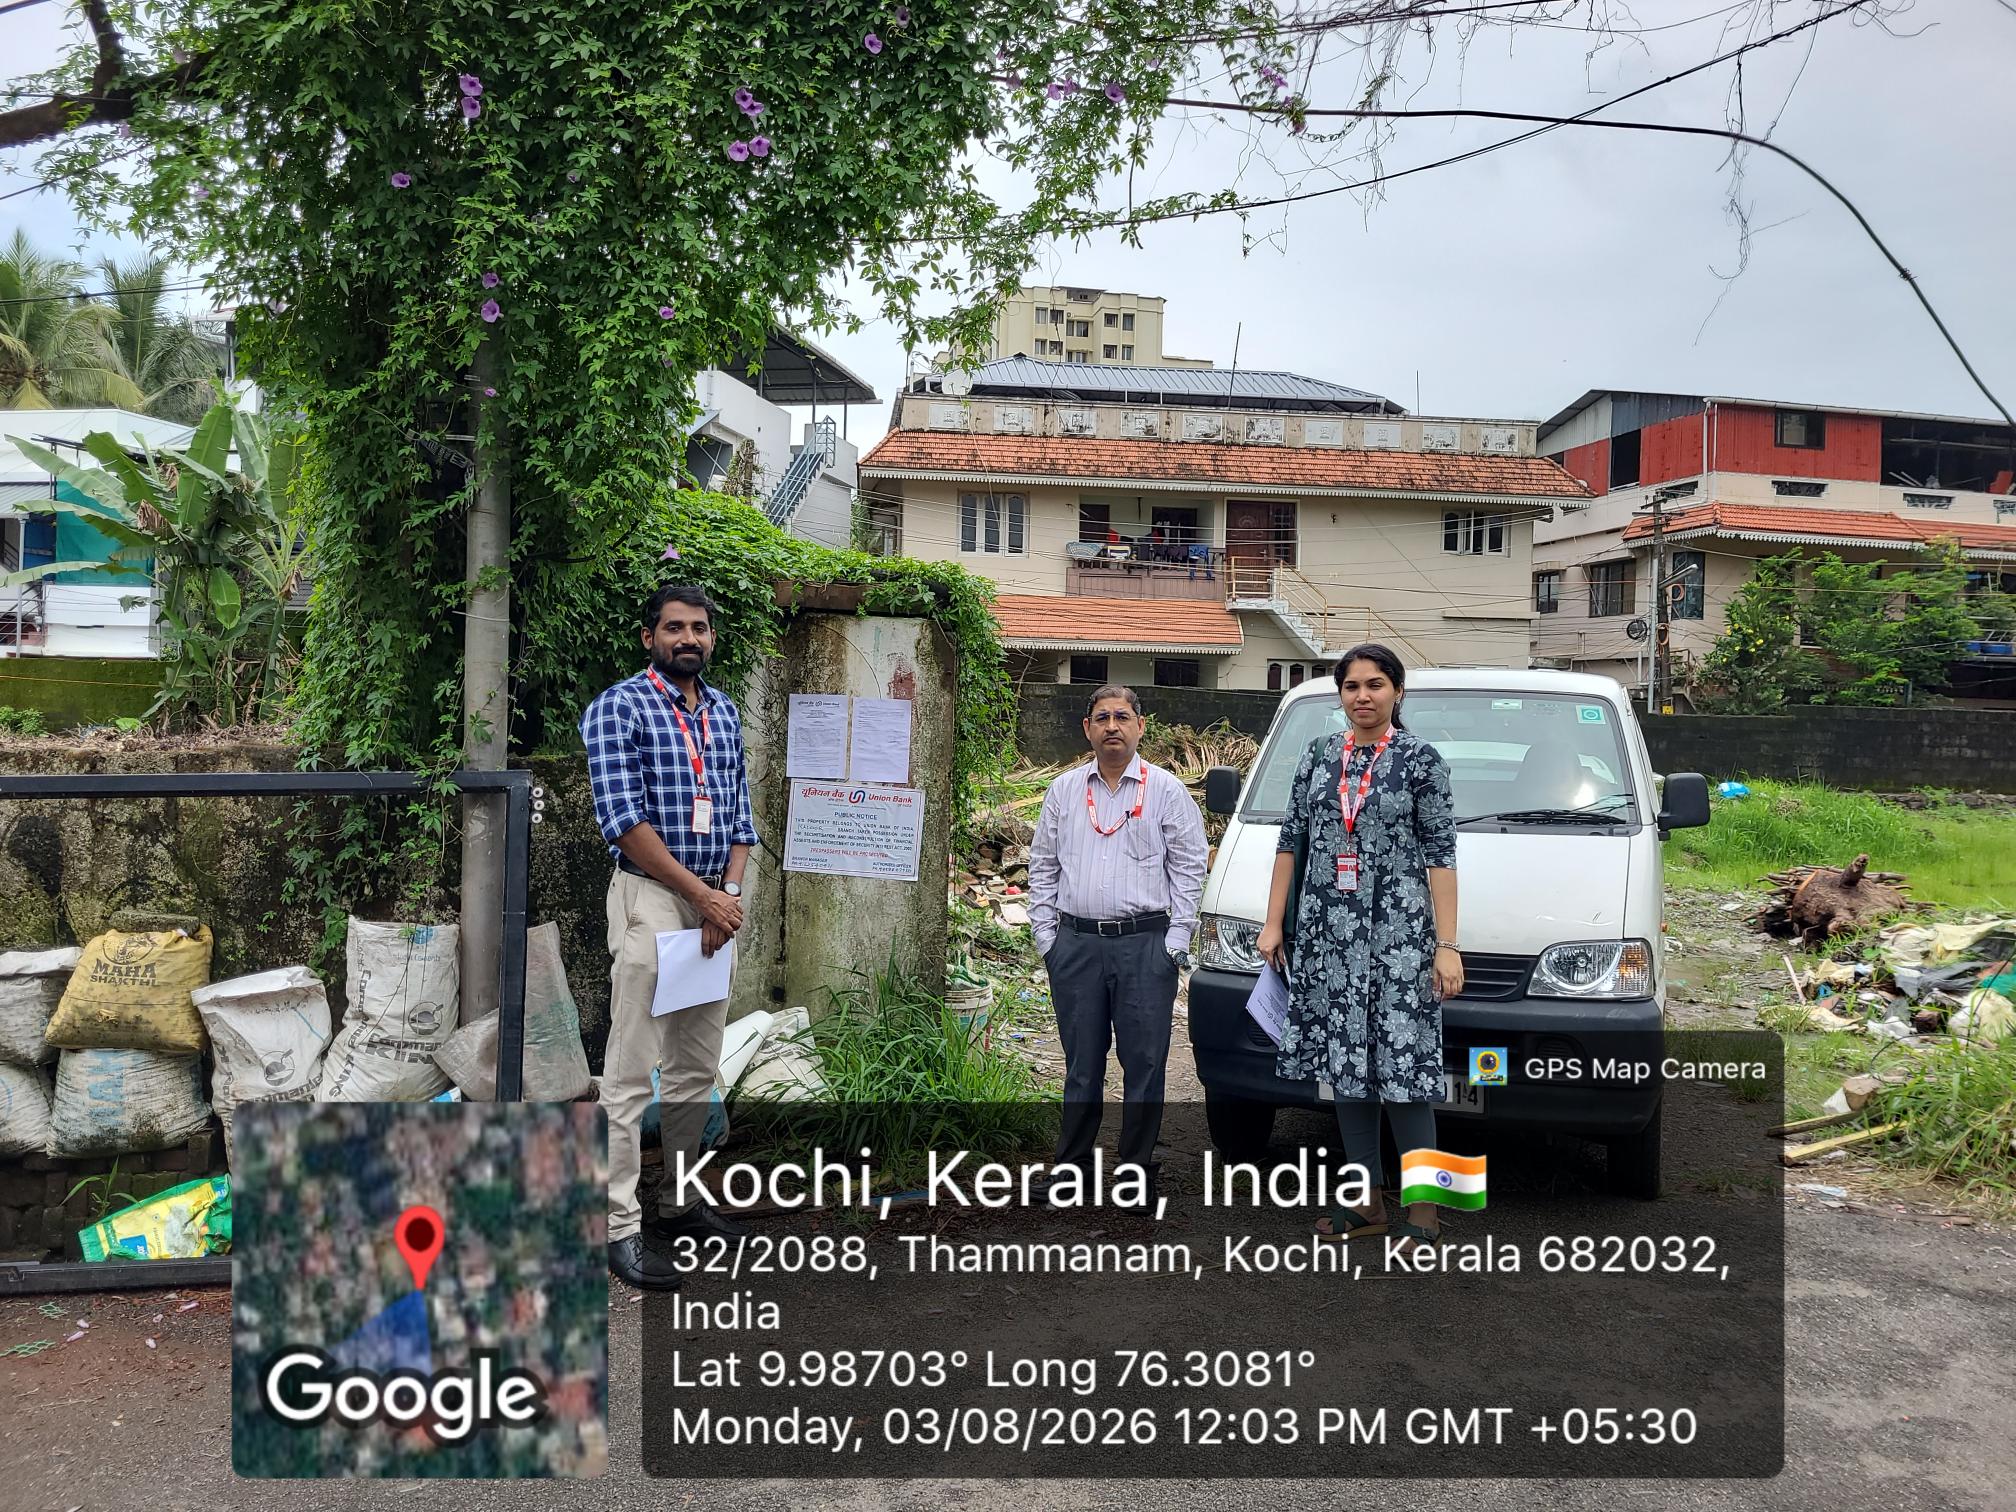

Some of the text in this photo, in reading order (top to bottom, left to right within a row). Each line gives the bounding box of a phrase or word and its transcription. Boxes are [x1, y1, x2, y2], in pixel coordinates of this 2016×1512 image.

[868, 793, 913, 804] Union Bank
[834, 811, 855, 819] PUBLIC
[92, 958, 157, 979] MAHA
[366, 1043, 437, 1065] KIN
[1444, 1080, 1478, 1106] 14
